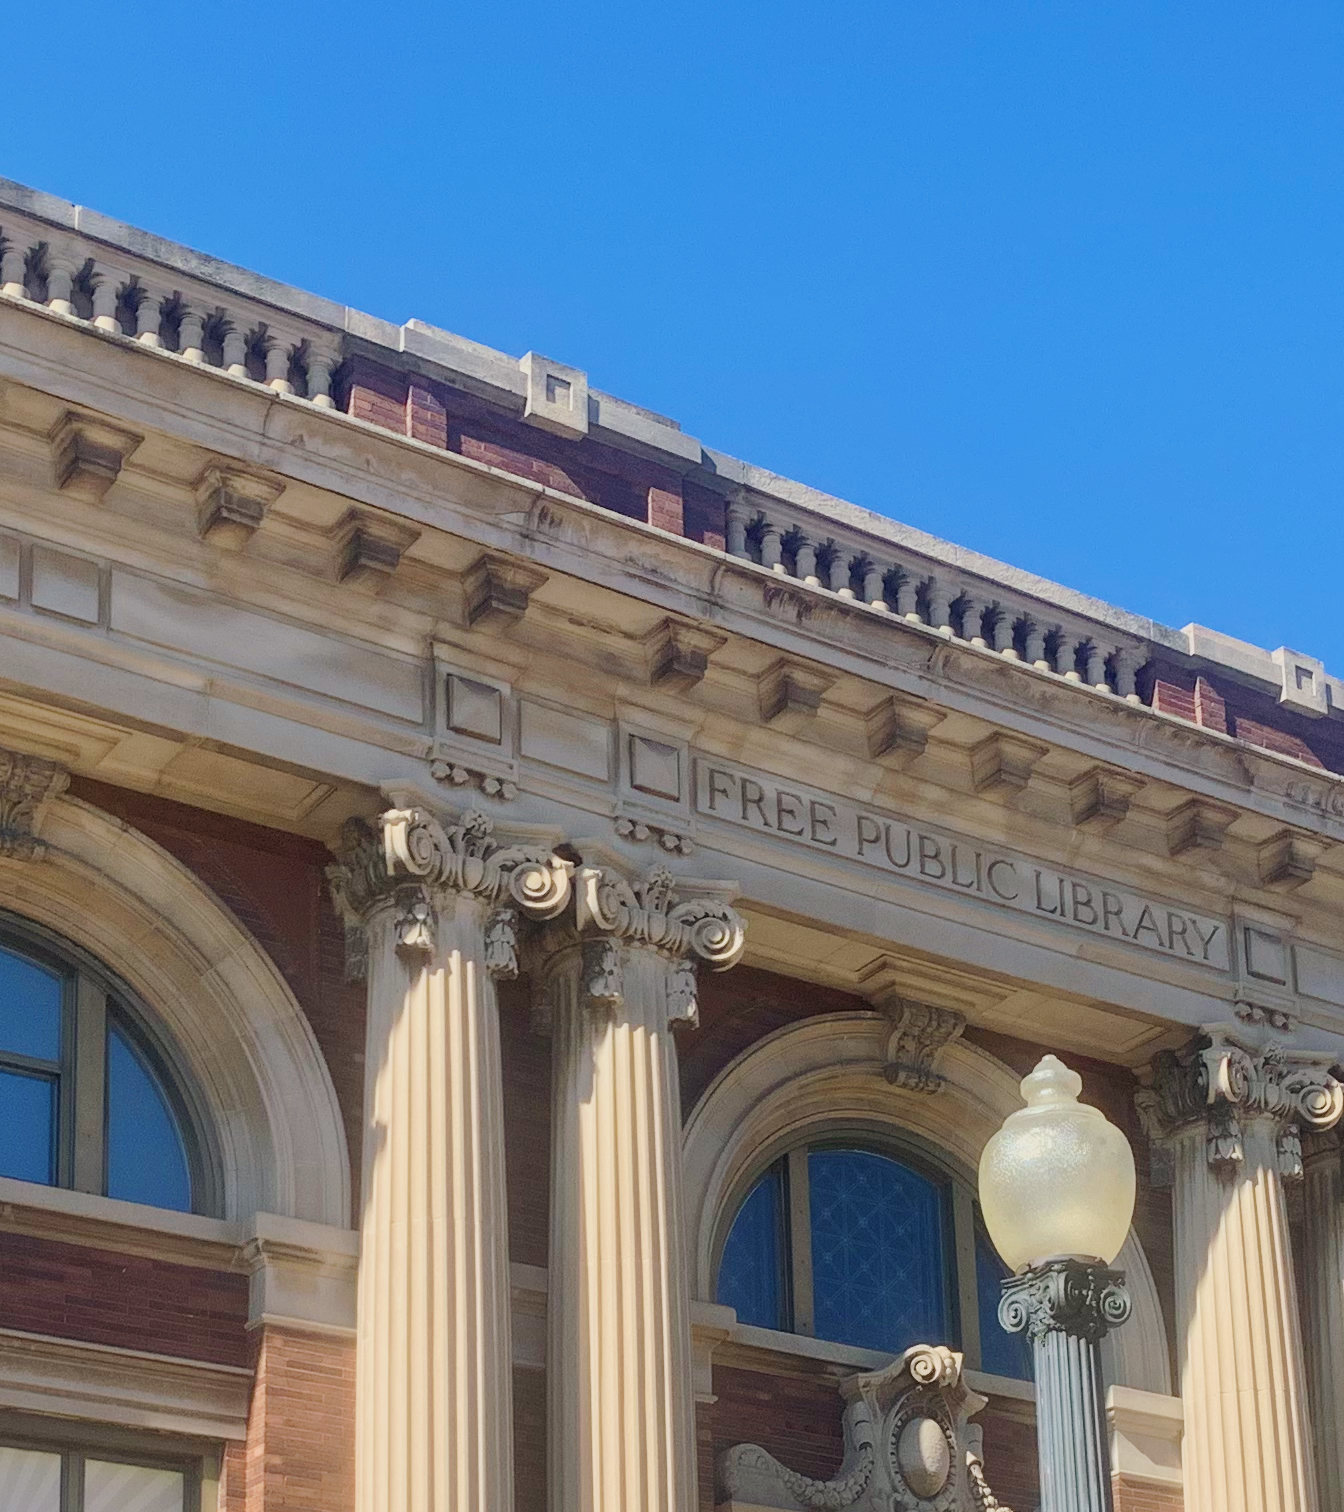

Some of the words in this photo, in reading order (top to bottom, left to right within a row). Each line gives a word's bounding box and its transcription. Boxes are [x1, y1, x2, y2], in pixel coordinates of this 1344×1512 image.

[705, 767, 839, 848] FREE
[855, 814, 1019, 901] PUBLIC
[1033, 869, 1220, 961] LIBRARY
